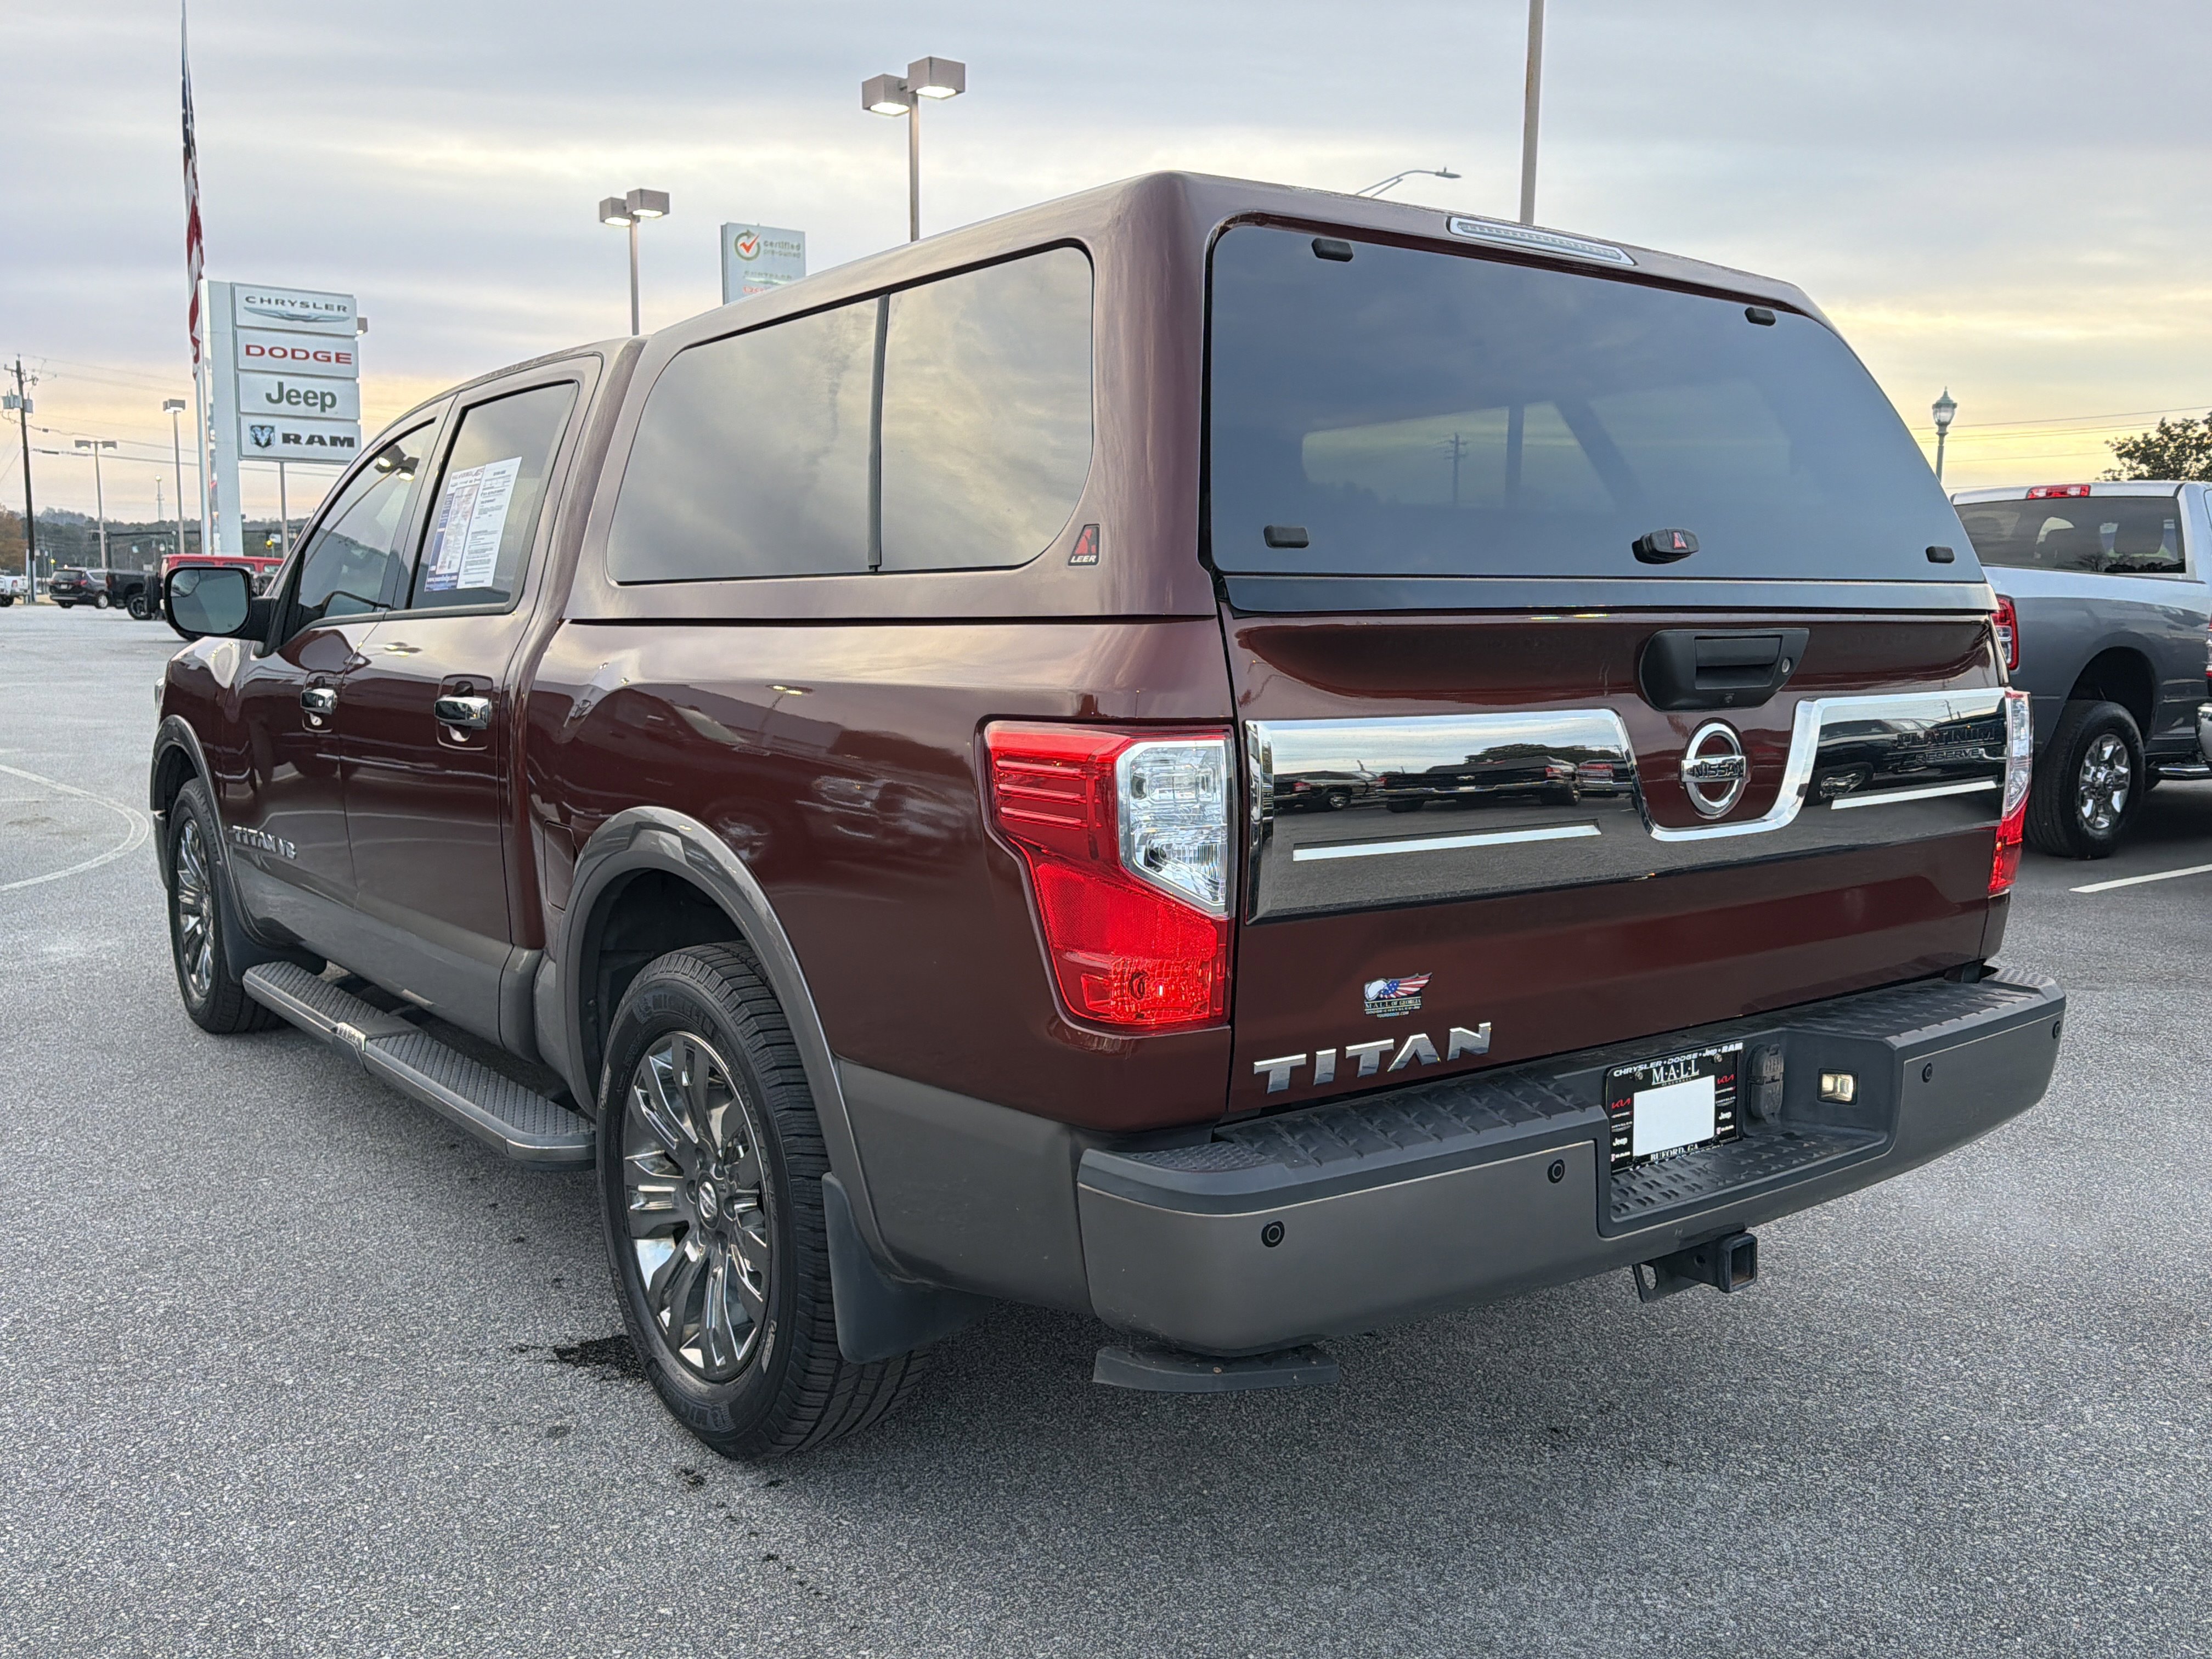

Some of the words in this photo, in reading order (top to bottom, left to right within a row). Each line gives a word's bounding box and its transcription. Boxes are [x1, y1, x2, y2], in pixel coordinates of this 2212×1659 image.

[245, 296, 348, 313] CHRYSLER
[245, 345, 353, 365] DODGE
[265, 381, 337, 413] Jeep
[281, 432, 355, 449] RAM
[1070, 555, 1097, 563] LEER
[1915, 748, 1979, 764] RESERVE
[1693, 761, 1744, 778] NISSAN
[1253, 1022, 1492, 1094] TITAN
[1613, 1060, 1662, 1077] CHRYSLER
[1667, 1052, 1698, 1064] DODGE
[1722, 1042, 1743, 1053] RAM
[1687, 1143, 1699, 1152] GA
